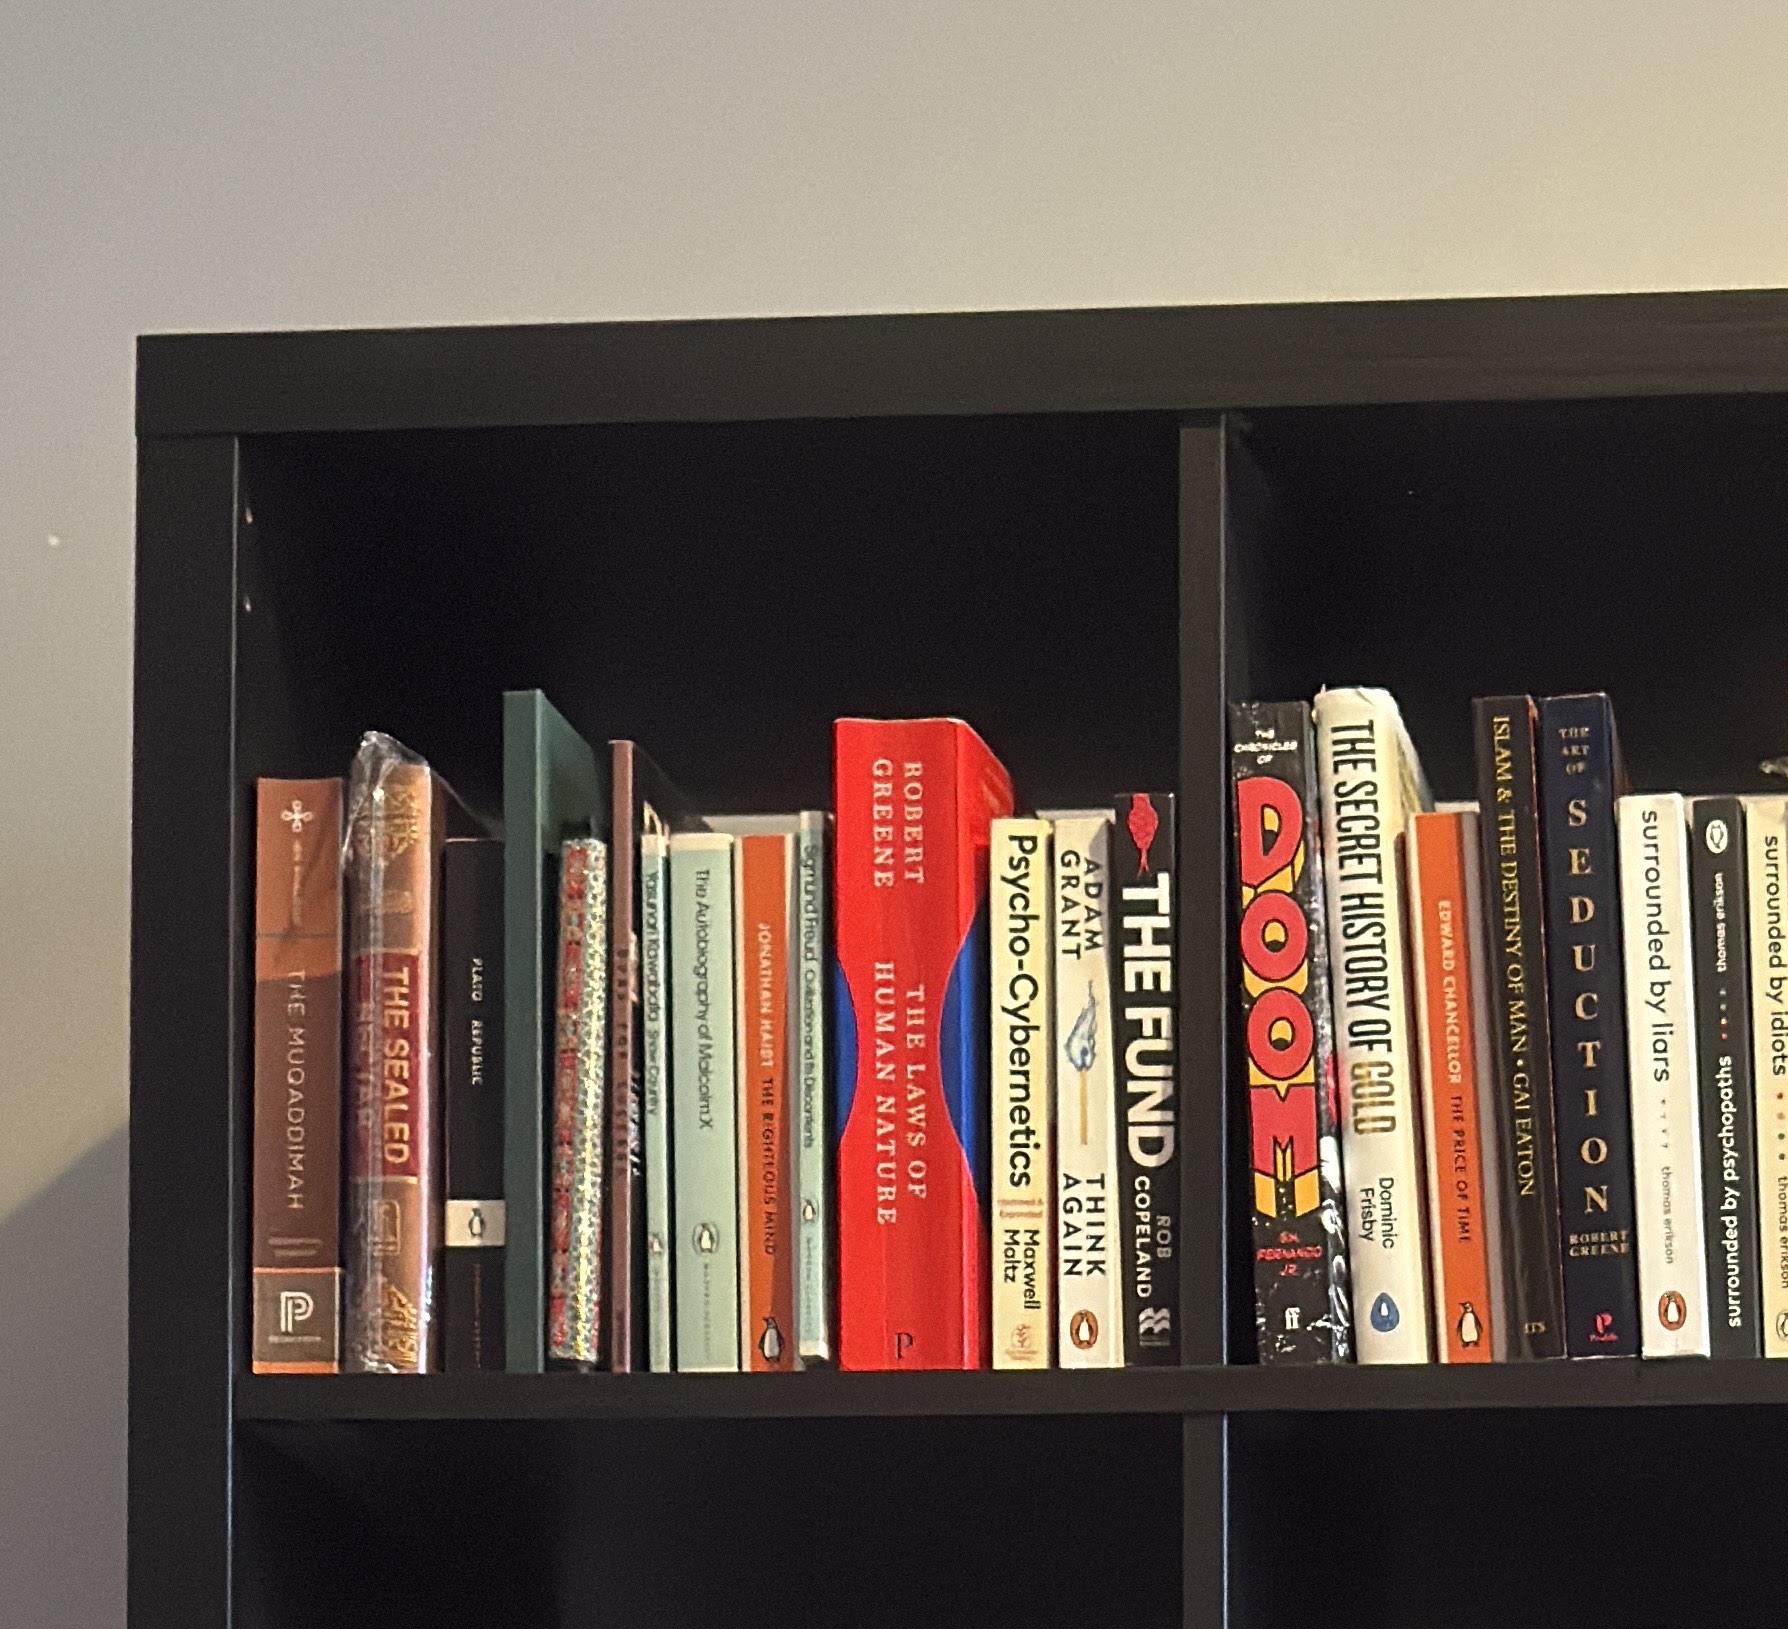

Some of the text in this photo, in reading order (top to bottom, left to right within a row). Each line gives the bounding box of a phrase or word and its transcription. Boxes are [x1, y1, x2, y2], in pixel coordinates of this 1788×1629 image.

[873, 759, 894, 887] GREENE
[905, 762, 924, 884] ROBERT
[1330, 720, 1396, 1135] THE SECRET HISTORY OF GOLD
[1004, 834, 1044, 1187] Psycho-Cybernetics
[1122, 873, 1176, 1167] THE FUND
[1238, 776, 1321, 1217] DOOM
[1568, 800, 1609, 1213] SEDUCTION
[284, 970, 306, 1211] THE MUQADDIMAH
[875, 962, 897, 1225] HUMAN NATURE
[906, 985, 926, 1199] THE LAWS OF
[1062, 1174, 1083, 1276] AGAIN
[1084, 1174, 1106, 1276] THINK
[1133, 1177, 1151, 1296] COPELAND
[1156, 1216, 1170, 1258] ROB
[1358, 1188, 1375, 1242] Frisby
[1379, 1177, 1394, 1249] Dominic
[1715, 1055, 1741, 1328] surrounded by psychopaths
[1004, 1229, 1018, 1283] Maltz
[1023, 1229, 1043, 1309] Maxwell
